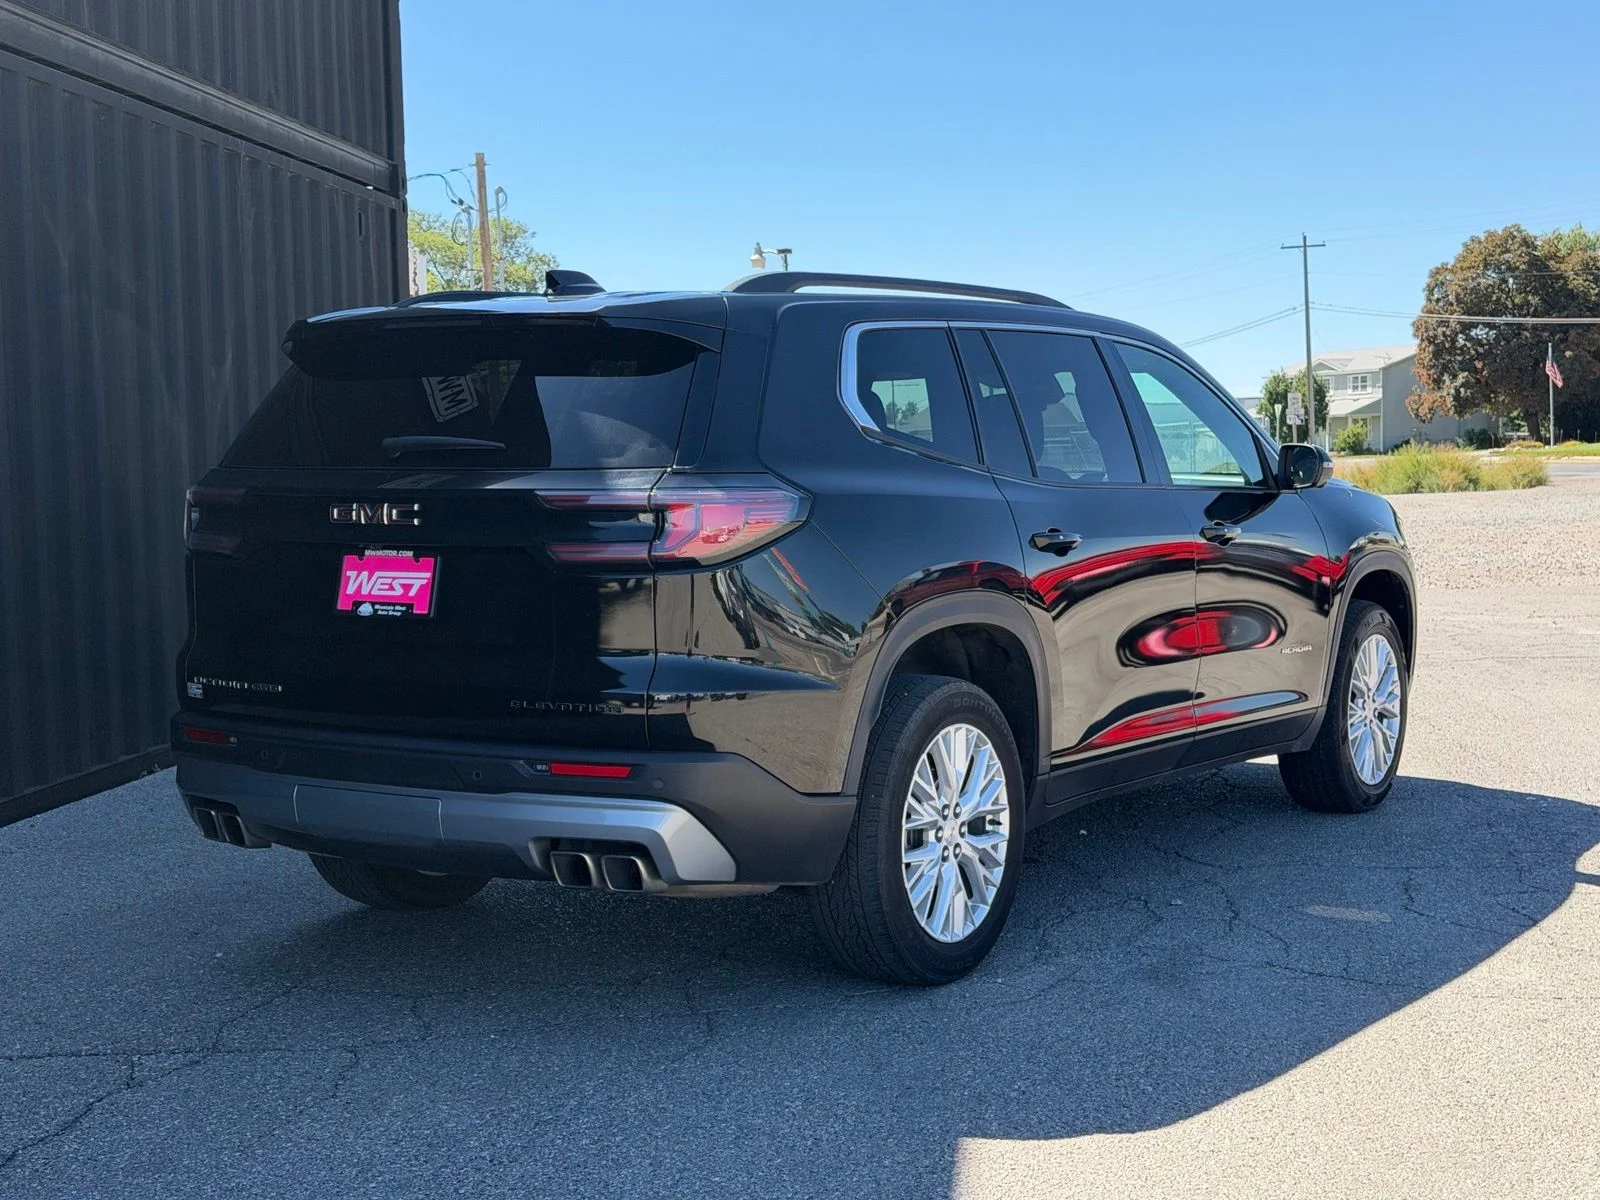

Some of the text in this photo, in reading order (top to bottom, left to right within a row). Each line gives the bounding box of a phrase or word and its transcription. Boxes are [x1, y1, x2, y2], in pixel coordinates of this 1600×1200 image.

[329, 502, 421, 525] GMC
[364, 549, 414, 557] MWMOTOR.COM
[345, 570, 432, 597] WEST
[1280, 645, 1312, 654] ACADIA
